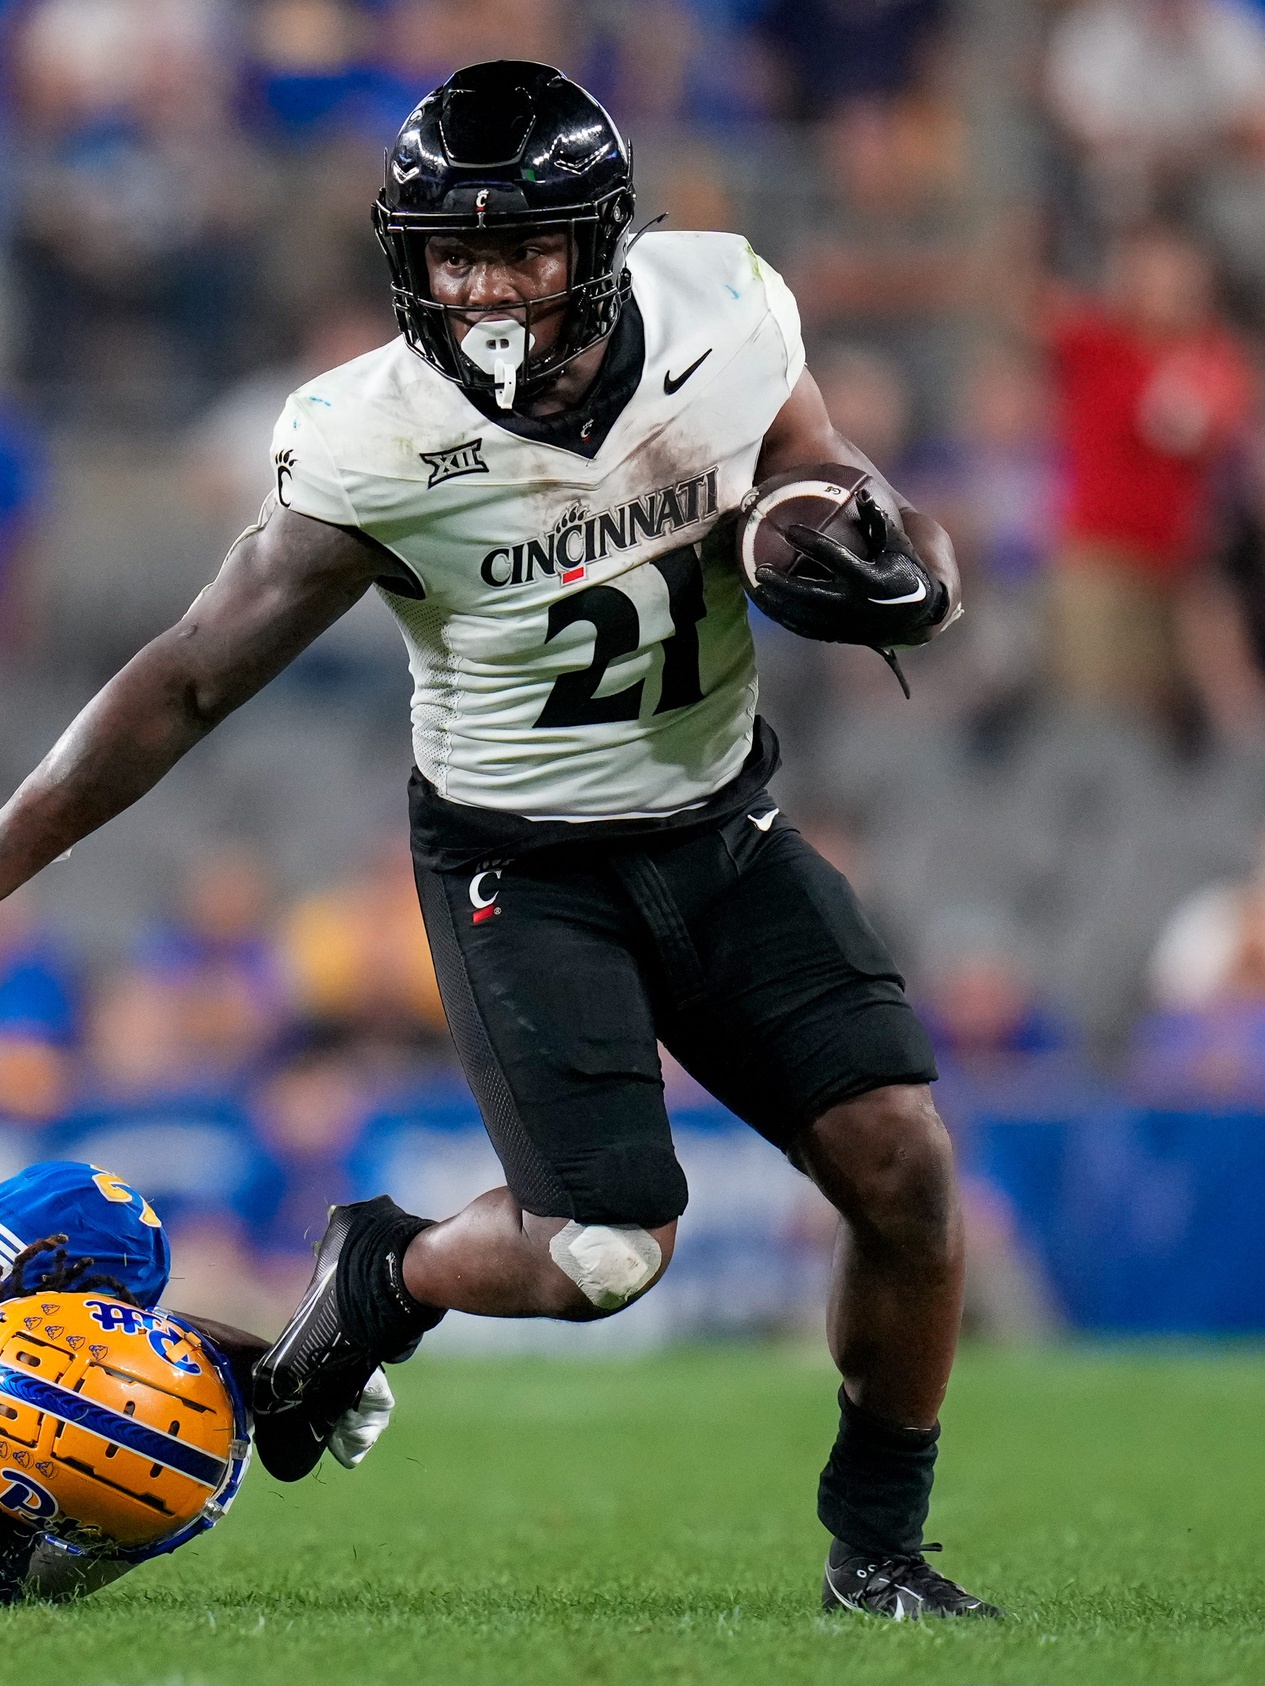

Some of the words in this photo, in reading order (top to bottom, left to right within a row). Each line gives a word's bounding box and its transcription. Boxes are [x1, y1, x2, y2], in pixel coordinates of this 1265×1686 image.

[429, 445, 485, 485] XII
[481, 465, 720, 588] CINCINNATI
[533, 545, 707, 729] 21
[468, 870, 502, 909] C
[82, 1300, 204, 1377] Pitt
